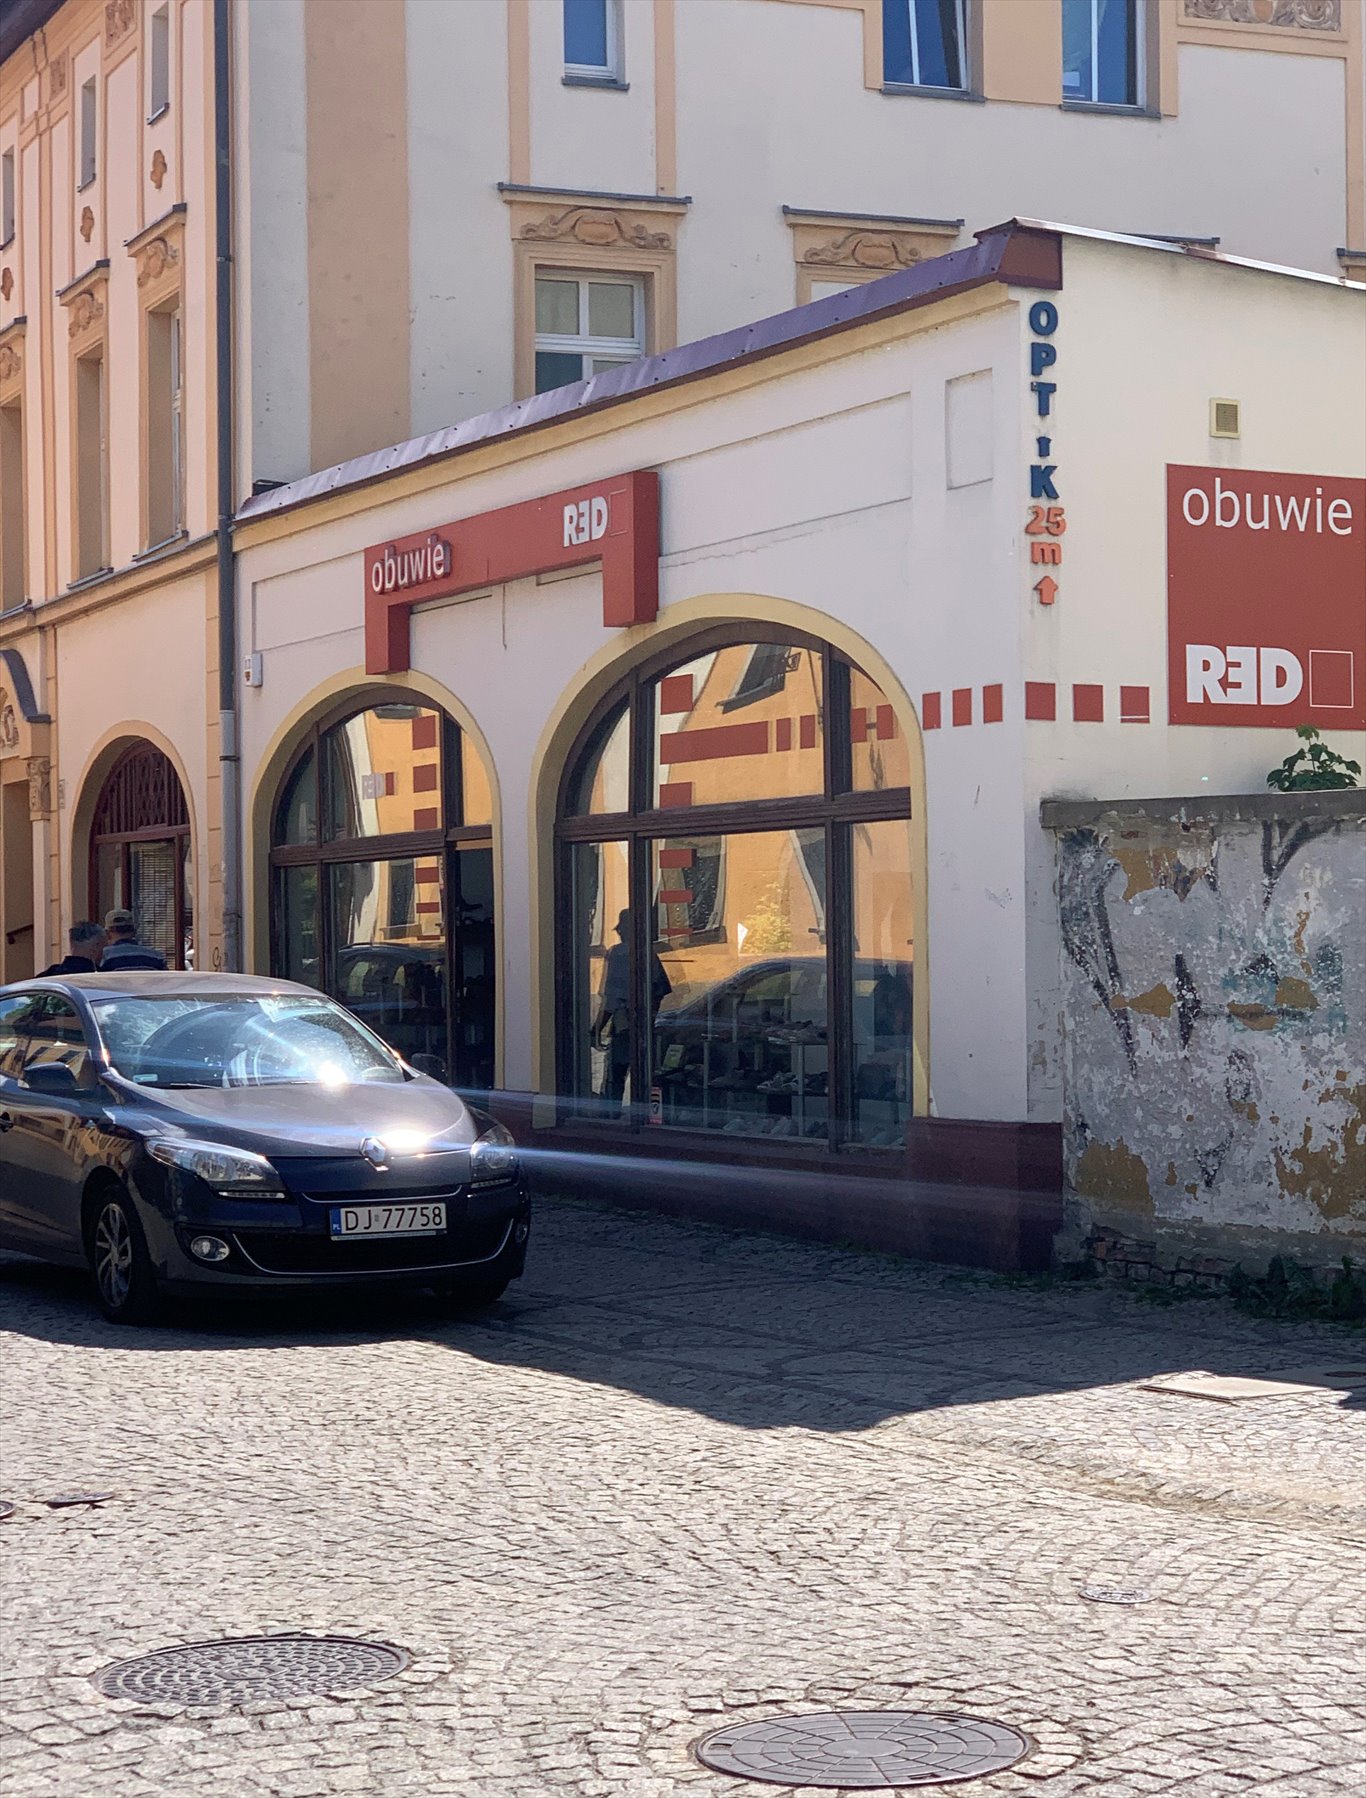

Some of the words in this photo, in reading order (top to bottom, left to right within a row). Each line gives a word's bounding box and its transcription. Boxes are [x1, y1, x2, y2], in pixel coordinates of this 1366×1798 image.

[1025, 506, 1066, 536] 25
[1183, 477, 1352, 535] obuwie
[371, 537, 446, 593] obuwie
[1031, 542, 1062, 565] m
[345, 1209, 372, 1231] DJ
[382, 1206, 442, 1229] 77758
